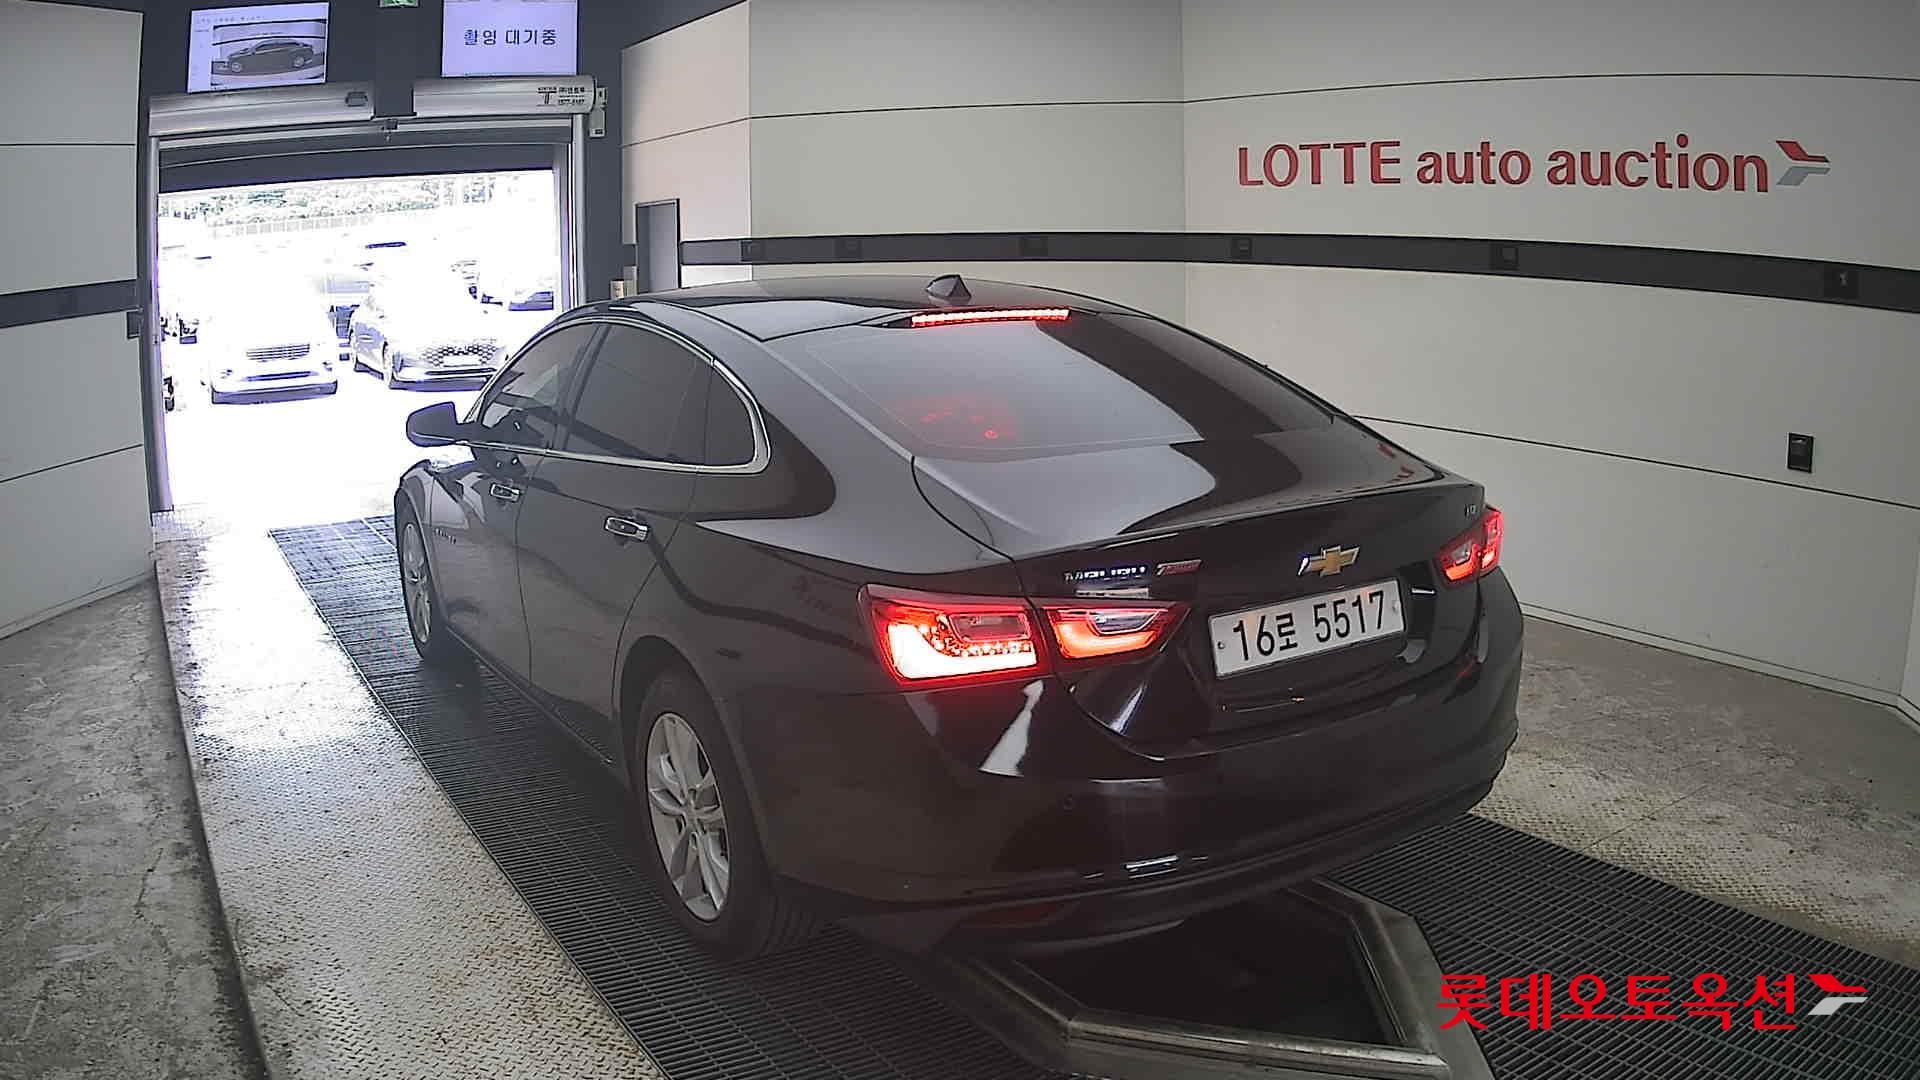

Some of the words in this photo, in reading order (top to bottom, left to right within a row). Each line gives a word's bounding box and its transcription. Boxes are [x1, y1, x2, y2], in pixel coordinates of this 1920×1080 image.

[505, 29, 557, 46] 대기중
[1238, 140, 1401, 188] LOTTE
[1416, 141, 1532, 185] auto
[1547, 134, 1769, 193] auction
[1233, 612, 1298, 661] 16로
[1313, 590, 1384, 643] 5517
